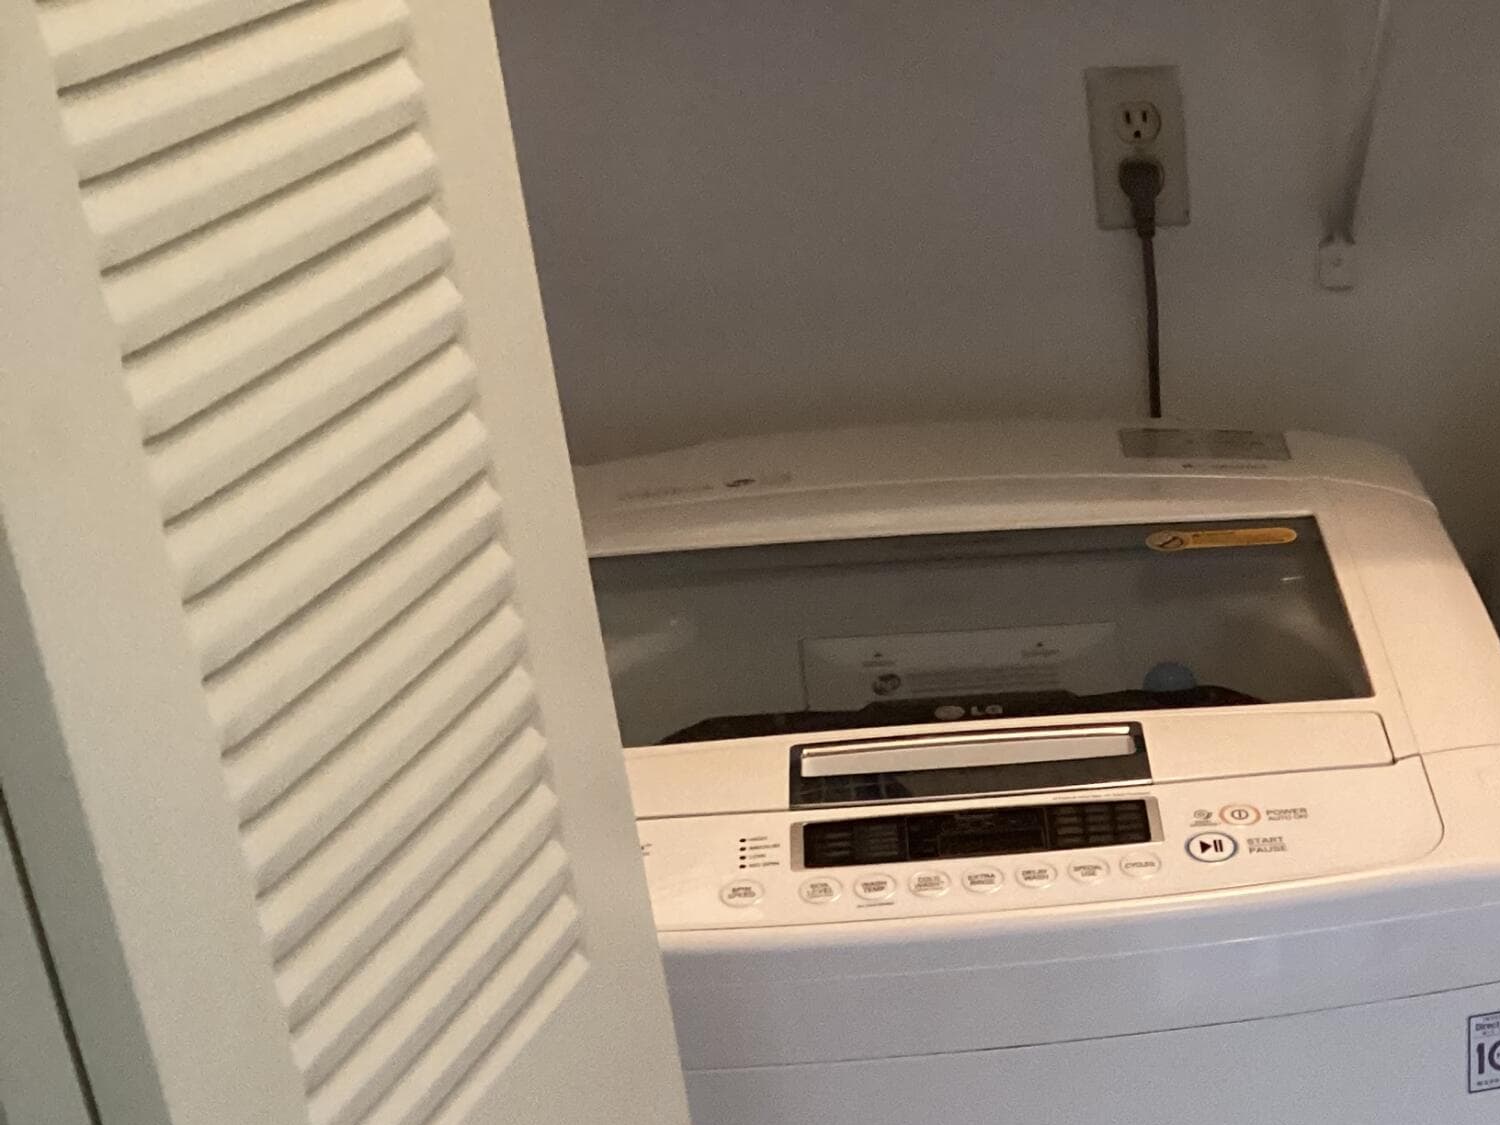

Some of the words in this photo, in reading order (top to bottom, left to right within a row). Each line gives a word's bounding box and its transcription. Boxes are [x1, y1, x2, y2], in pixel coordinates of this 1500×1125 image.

[1266, 807, 1308, 816] POWER
[1246, 837, 1284, 846] START
[1248, 845, 1288, 854] PAUSE
